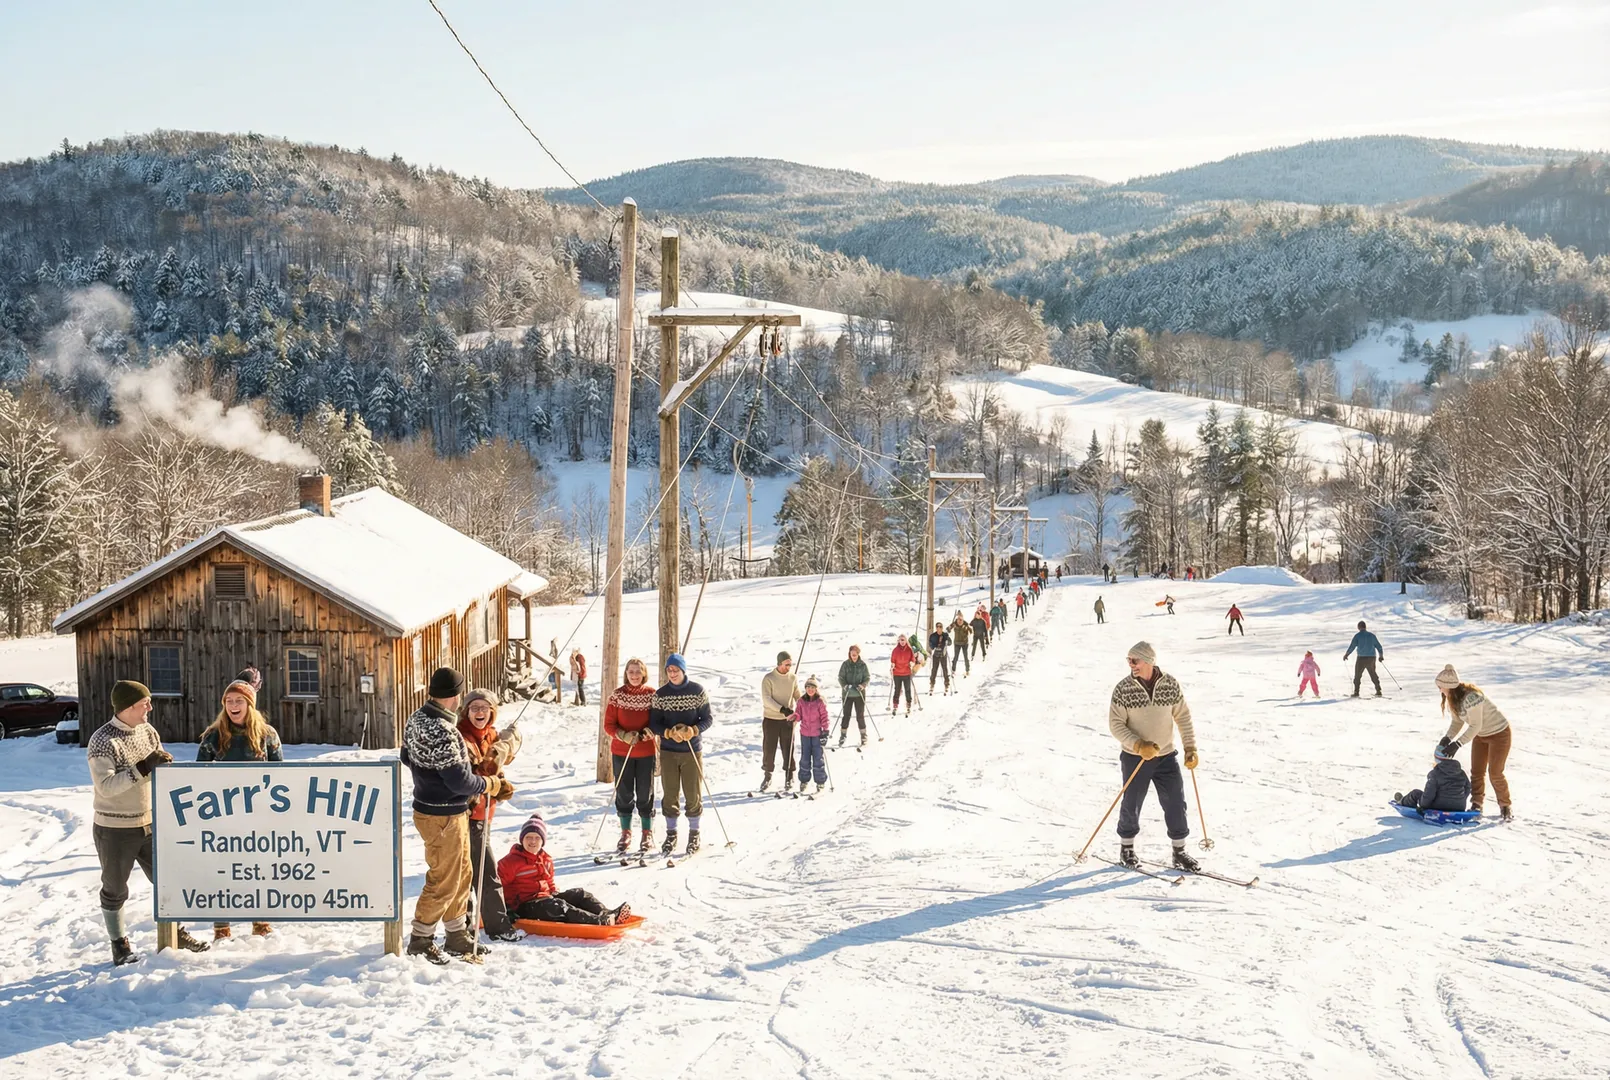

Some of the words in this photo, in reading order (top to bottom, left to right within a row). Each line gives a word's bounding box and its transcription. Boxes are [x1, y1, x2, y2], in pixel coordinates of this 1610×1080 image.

[169, 774, 291, 827] Farr's
[306, 776, 381, 826] Hill
[201, 830, 311, 858] Randolph,
[316, 830, 347, 853] VT
[232, 862, 266, 881] Est.
[270, 862, 316, 881] 1962
[182, 888, 261, 909] Vertical
[266, 888, 317, 914] Drop
